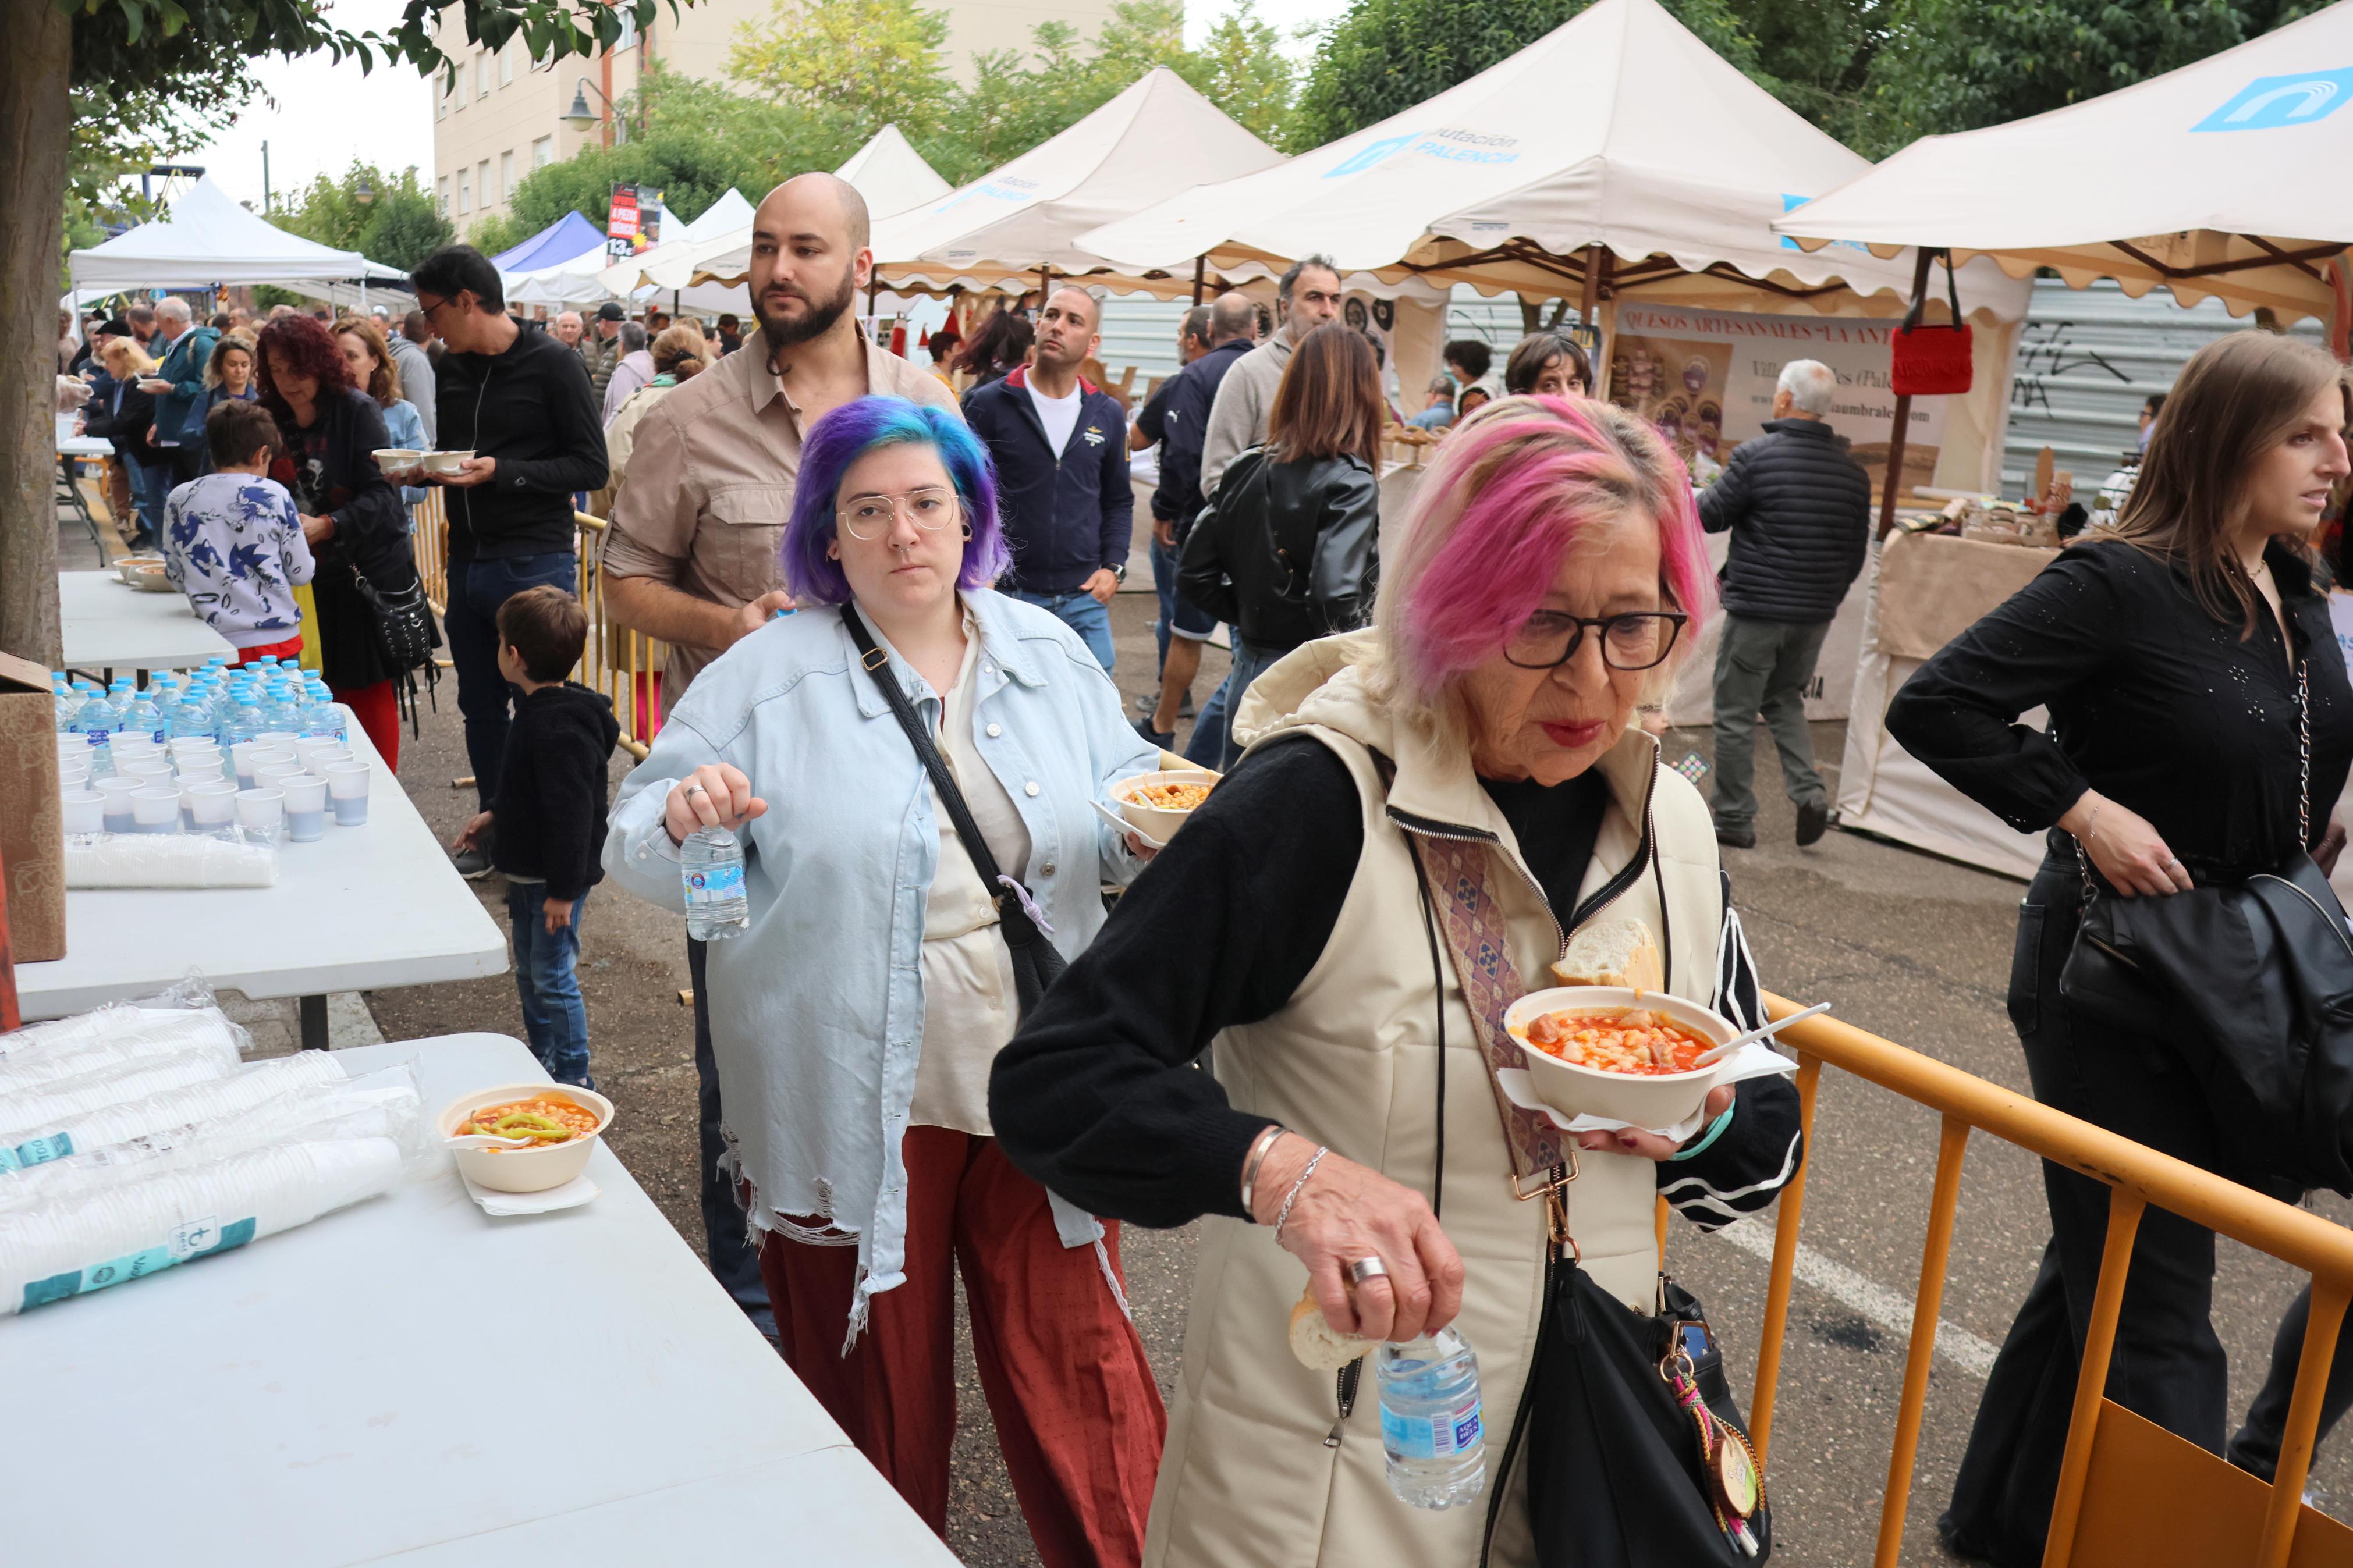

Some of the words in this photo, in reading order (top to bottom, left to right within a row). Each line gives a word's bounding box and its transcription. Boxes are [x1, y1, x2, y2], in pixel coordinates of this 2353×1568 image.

[1415, 141, 1520, 163] PALENCIA
[1626, 311, 1687, 330] QUESOS
[1695, 316, 1812, 339] ARTESANALES
[1857, 327, 1892, 345] ANT
[31, 1140, 50, 1161] 100
[1458, 1417, 1478, 1432] AQUA
